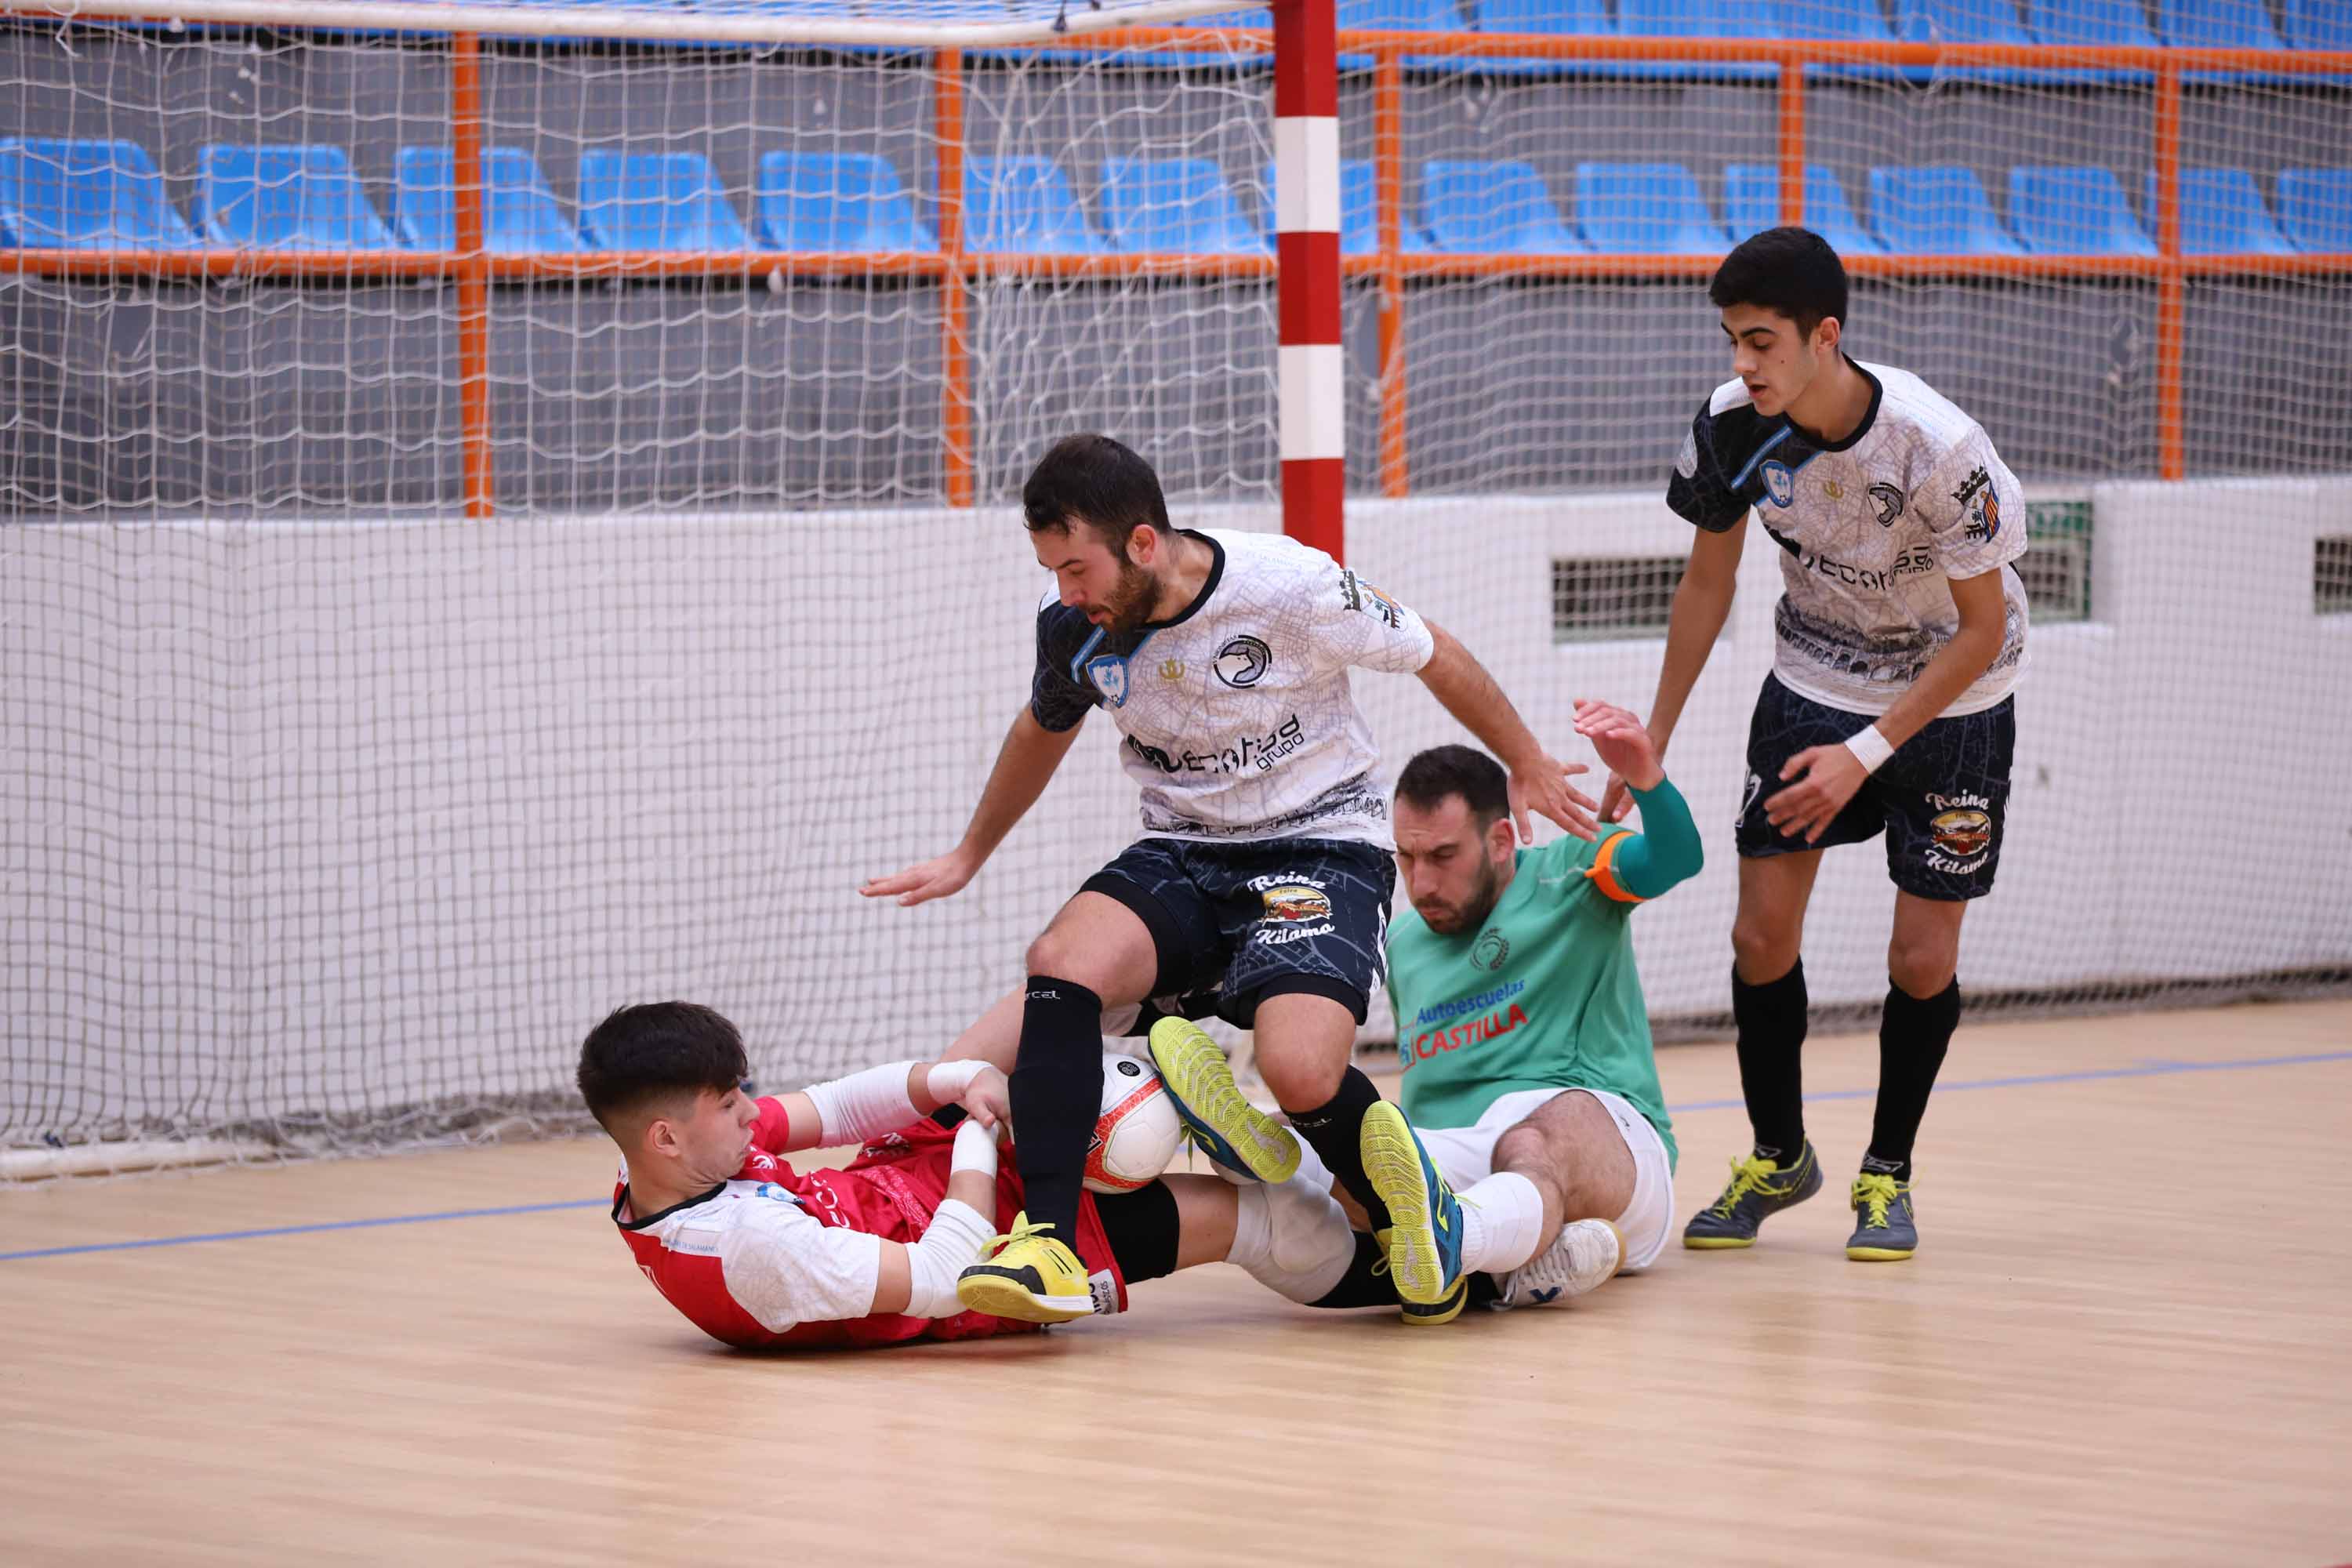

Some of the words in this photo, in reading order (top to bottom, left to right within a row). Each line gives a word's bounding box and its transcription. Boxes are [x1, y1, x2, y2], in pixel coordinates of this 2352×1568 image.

[1257, 732, 1305, 771] grupo
[1926, 789, 1989, 811] Reina
[1247, 870, 1327, 892] Reina
[1255, 923, 1335, 945] Kilama
[1417, 979, 1525, 1025] Autoescuelas
[1416, 1004, 1528, 1059] CASTILLA
